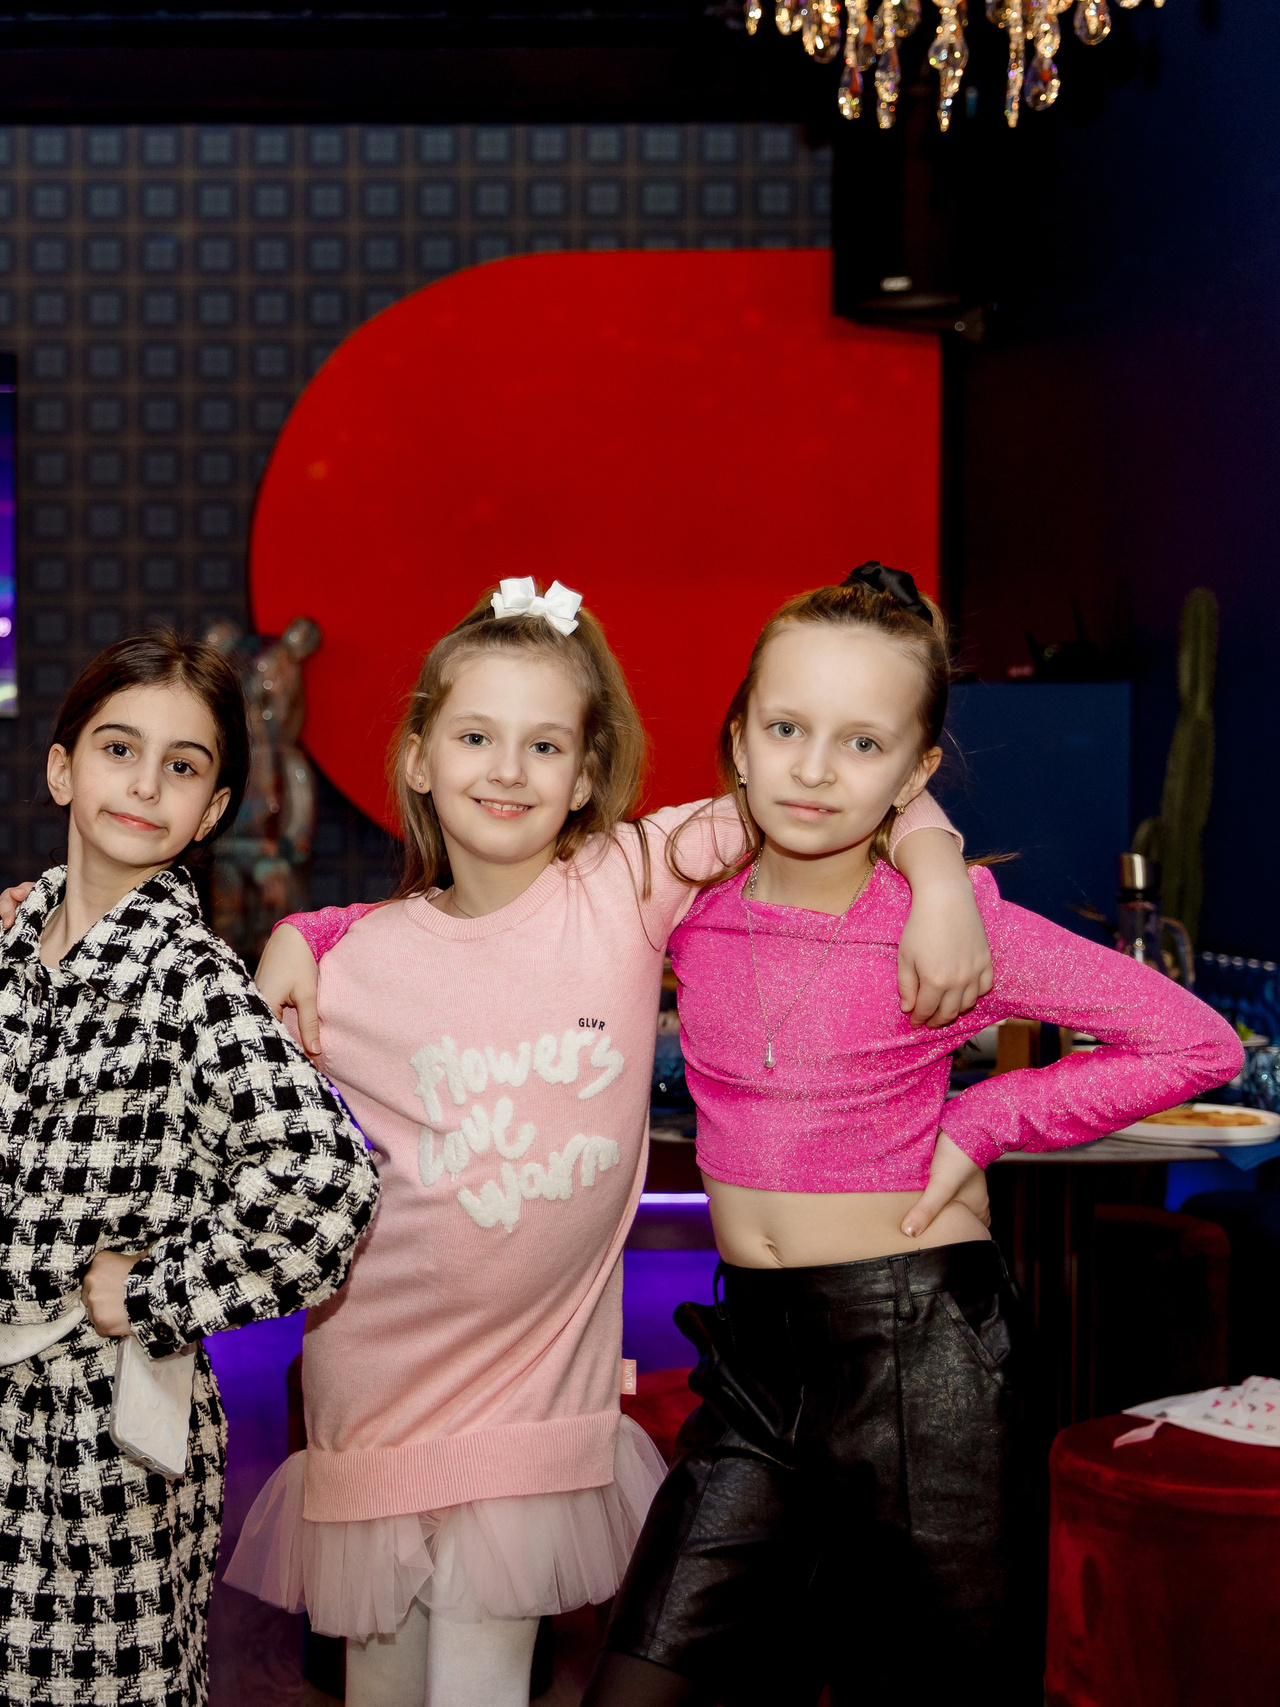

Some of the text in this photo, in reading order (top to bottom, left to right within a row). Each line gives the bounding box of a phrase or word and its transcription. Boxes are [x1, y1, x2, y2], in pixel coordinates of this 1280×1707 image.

[578, 1017, 606, 1031] GLVR
[410, 1030, 624, 1122] Flowers
[625, 1364, 634, 1389] GLVR
